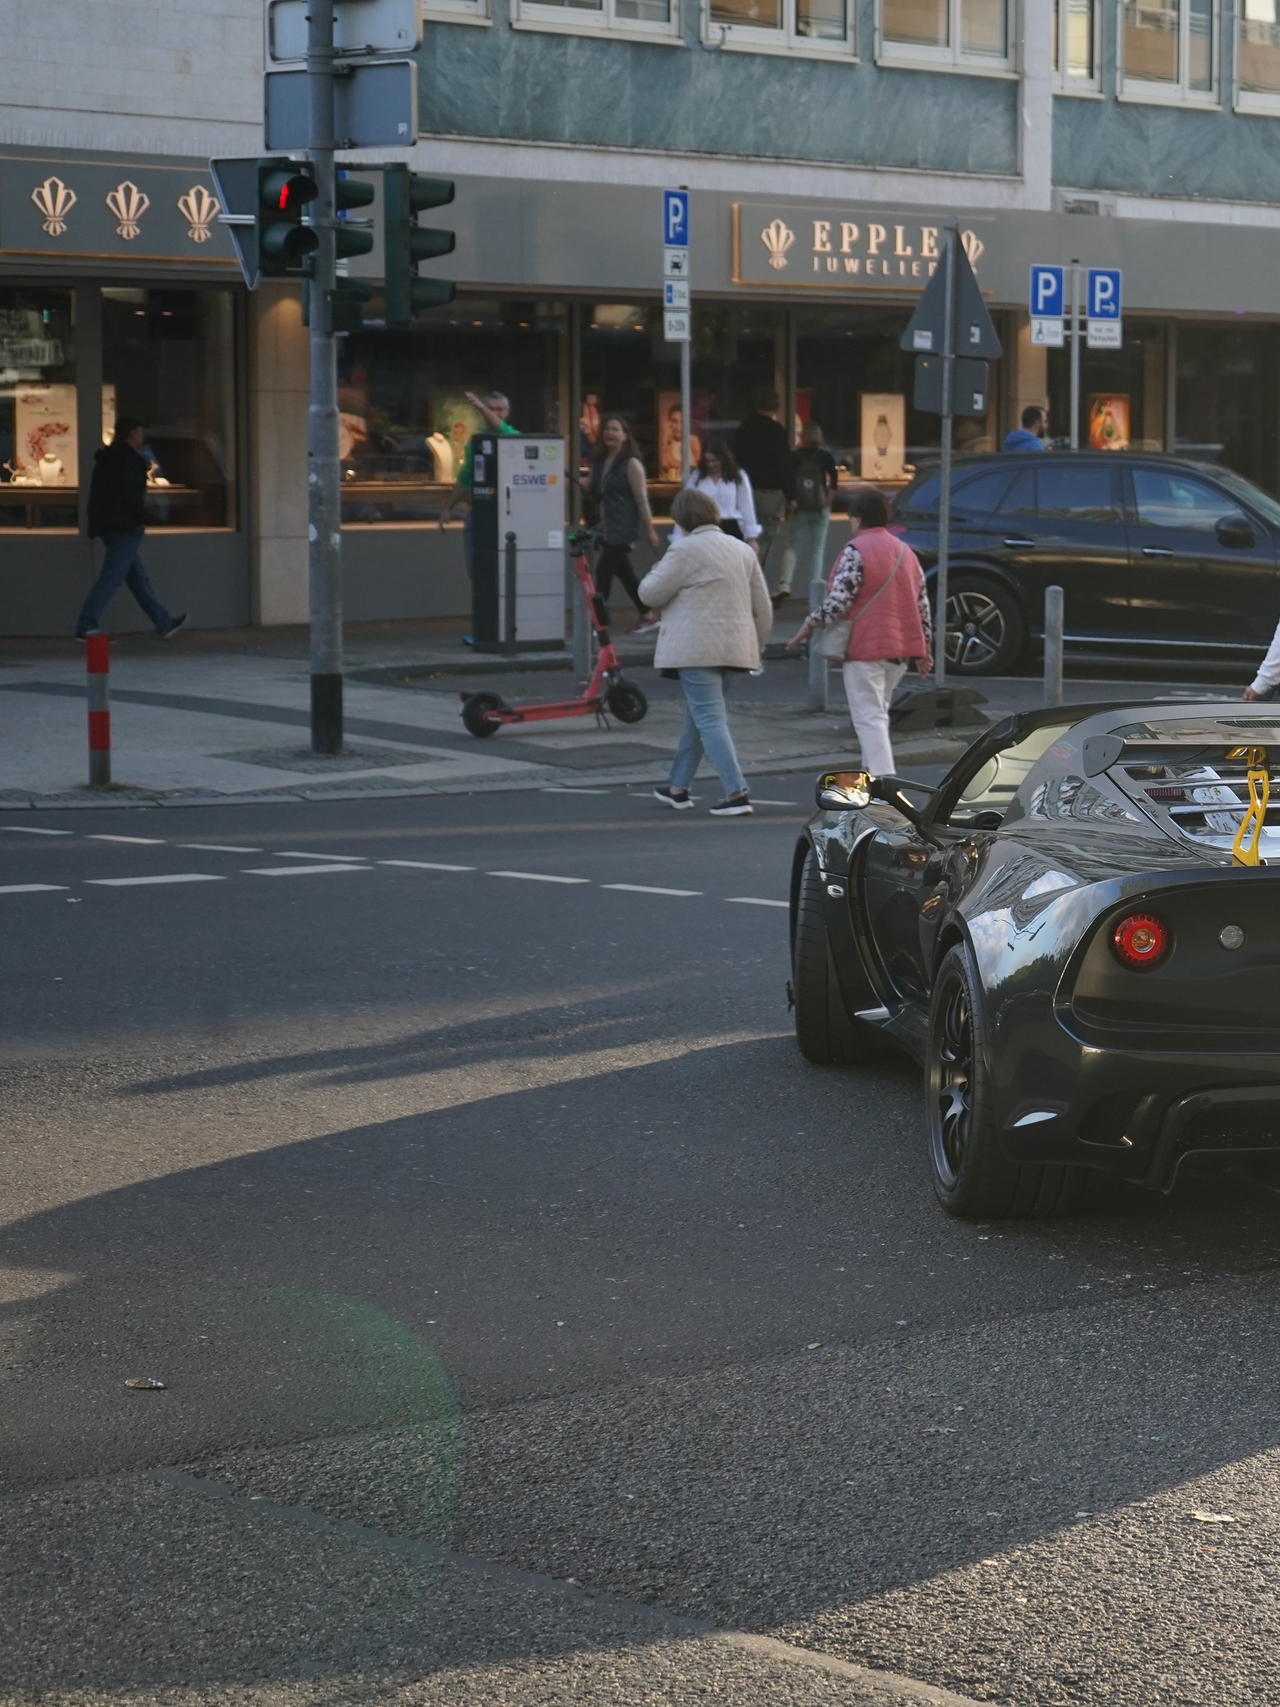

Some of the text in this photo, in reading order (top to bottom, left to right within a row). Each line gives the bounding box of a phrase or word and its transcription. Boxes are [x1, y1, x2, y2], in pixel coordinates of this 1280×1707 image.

[668, 197, 684, 239] P
[811, 219, 939, 258] EPPLE
[1037, 271, 1058, 311] P
[1094, 275, 1114, 314] P
[512, 474, 547, 485] ESWE
